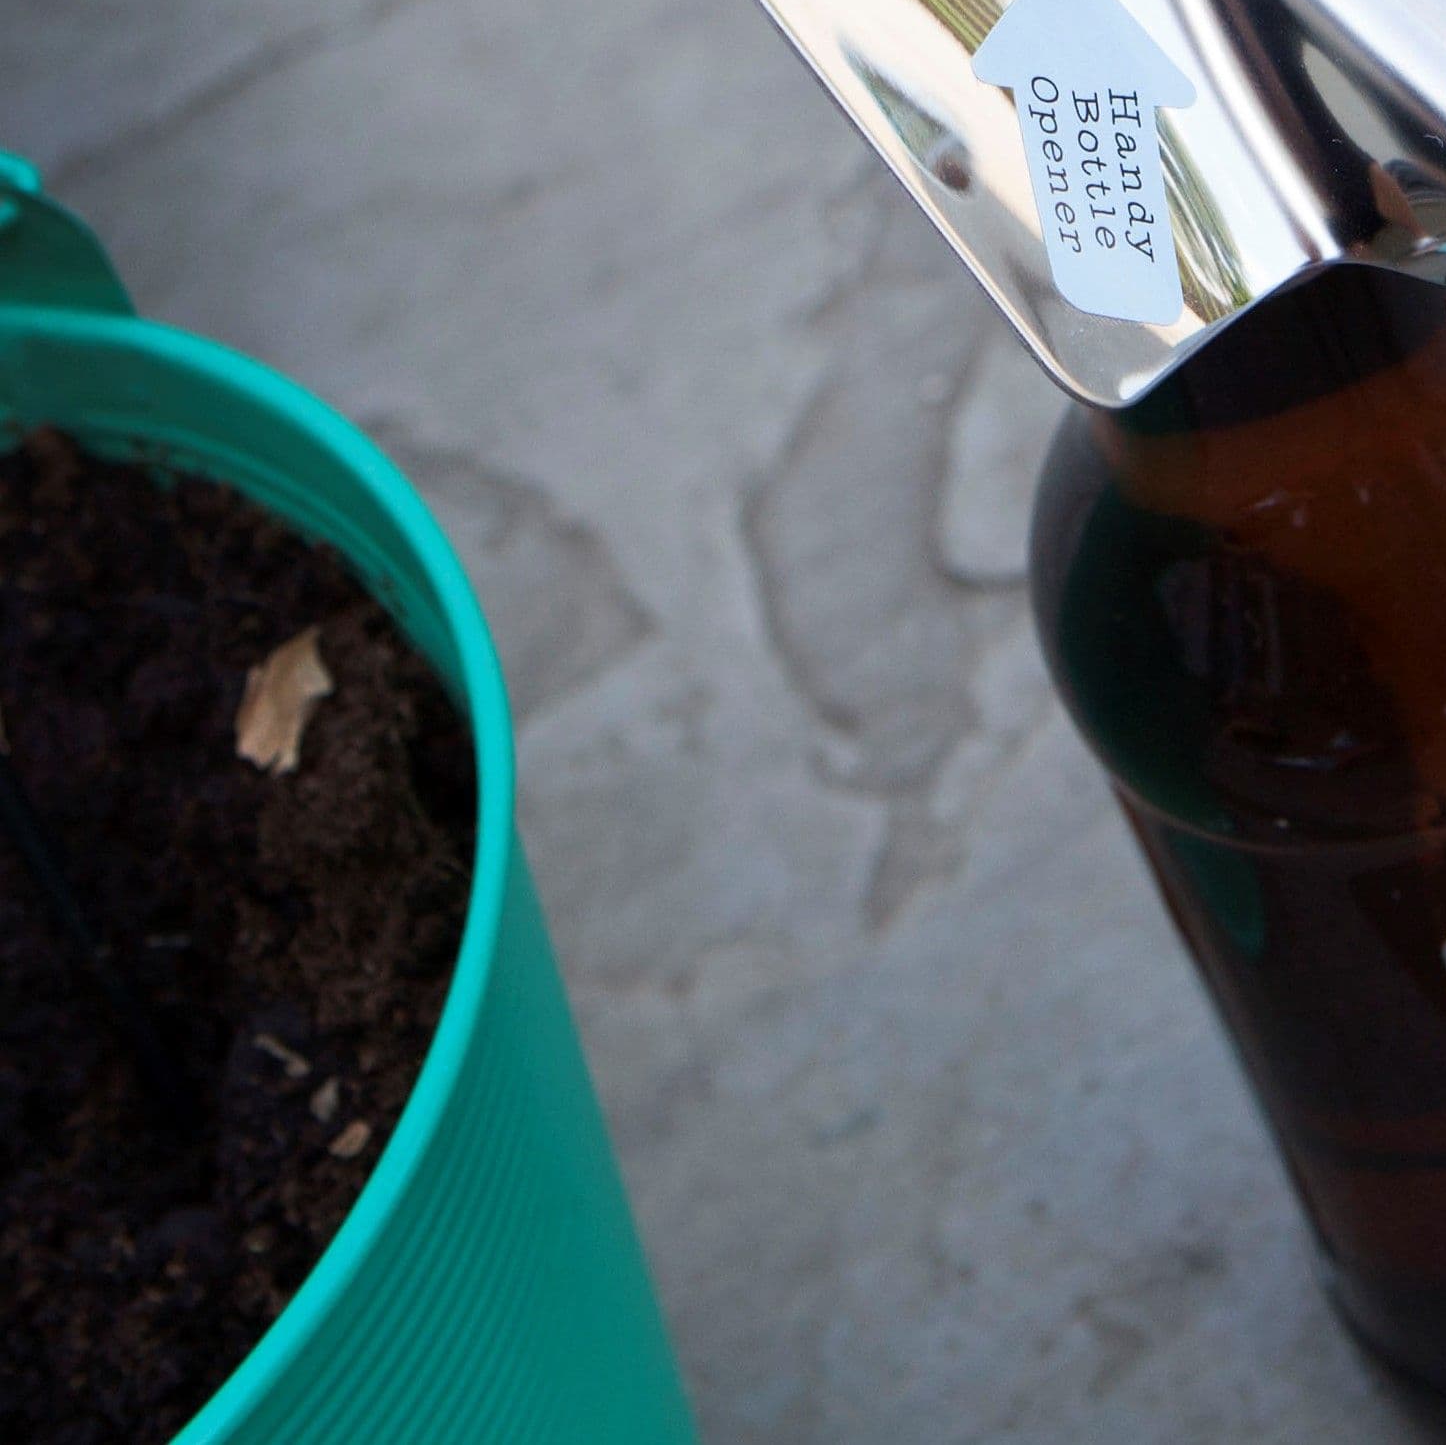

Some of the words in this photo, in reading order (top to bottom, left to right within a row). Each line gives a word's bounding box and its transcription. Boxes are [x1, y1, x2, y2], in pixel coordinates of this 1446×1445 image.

[1029, 75, 1081, 253] Opener
[1072, 90, 1116, 250] Bottle
[1108, 88, 1155, 262] Handy
